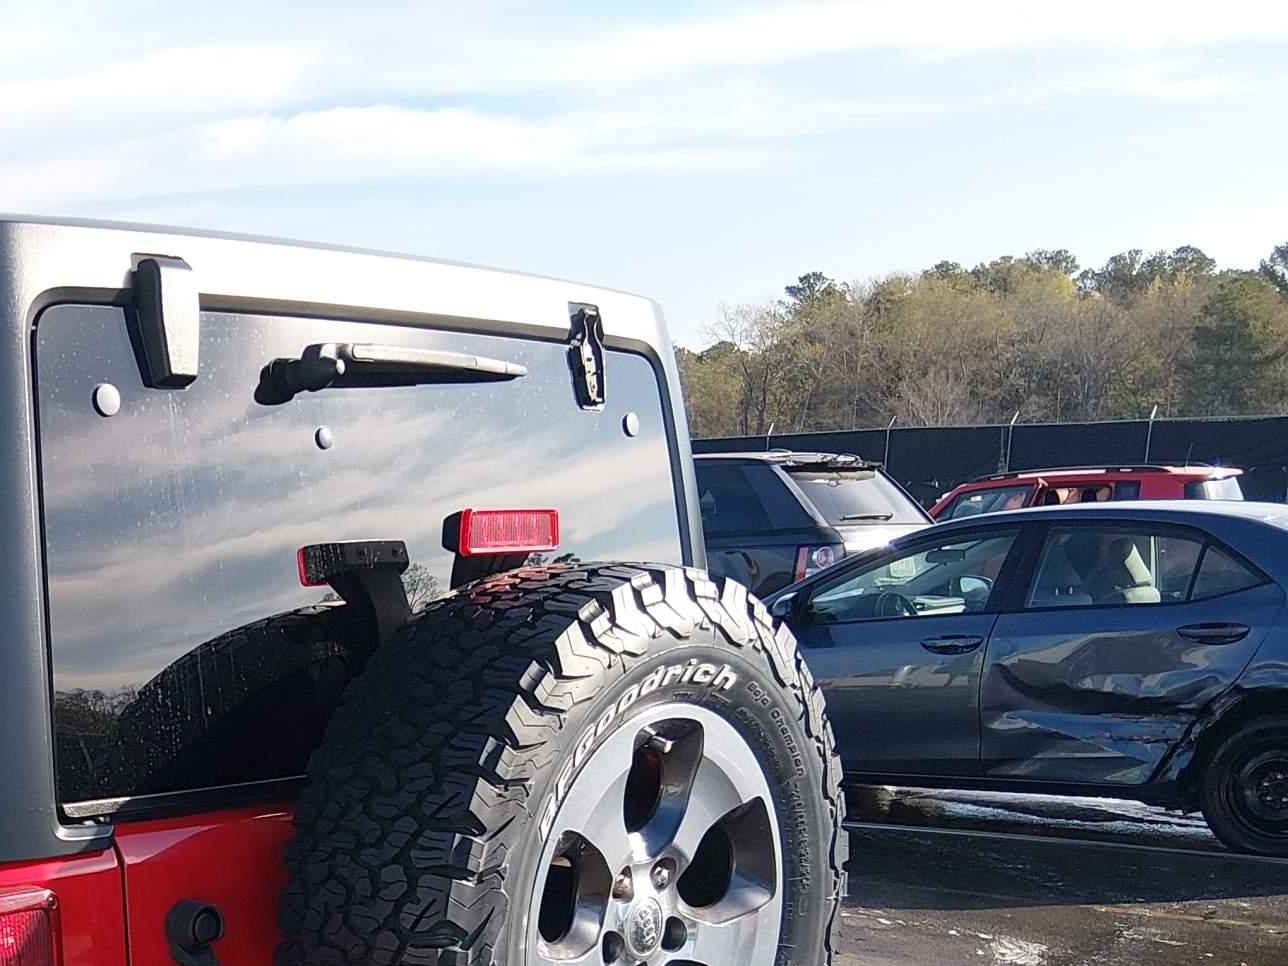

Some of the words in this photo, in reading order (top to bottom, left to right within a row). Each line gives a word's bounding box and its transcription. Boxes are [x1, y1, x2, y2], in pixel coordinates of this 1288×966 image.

[539, 658, 738, 842] BFGoodrich
[746, 680, 771, 707] Baja
[770, 707, 806, 778] Champion
